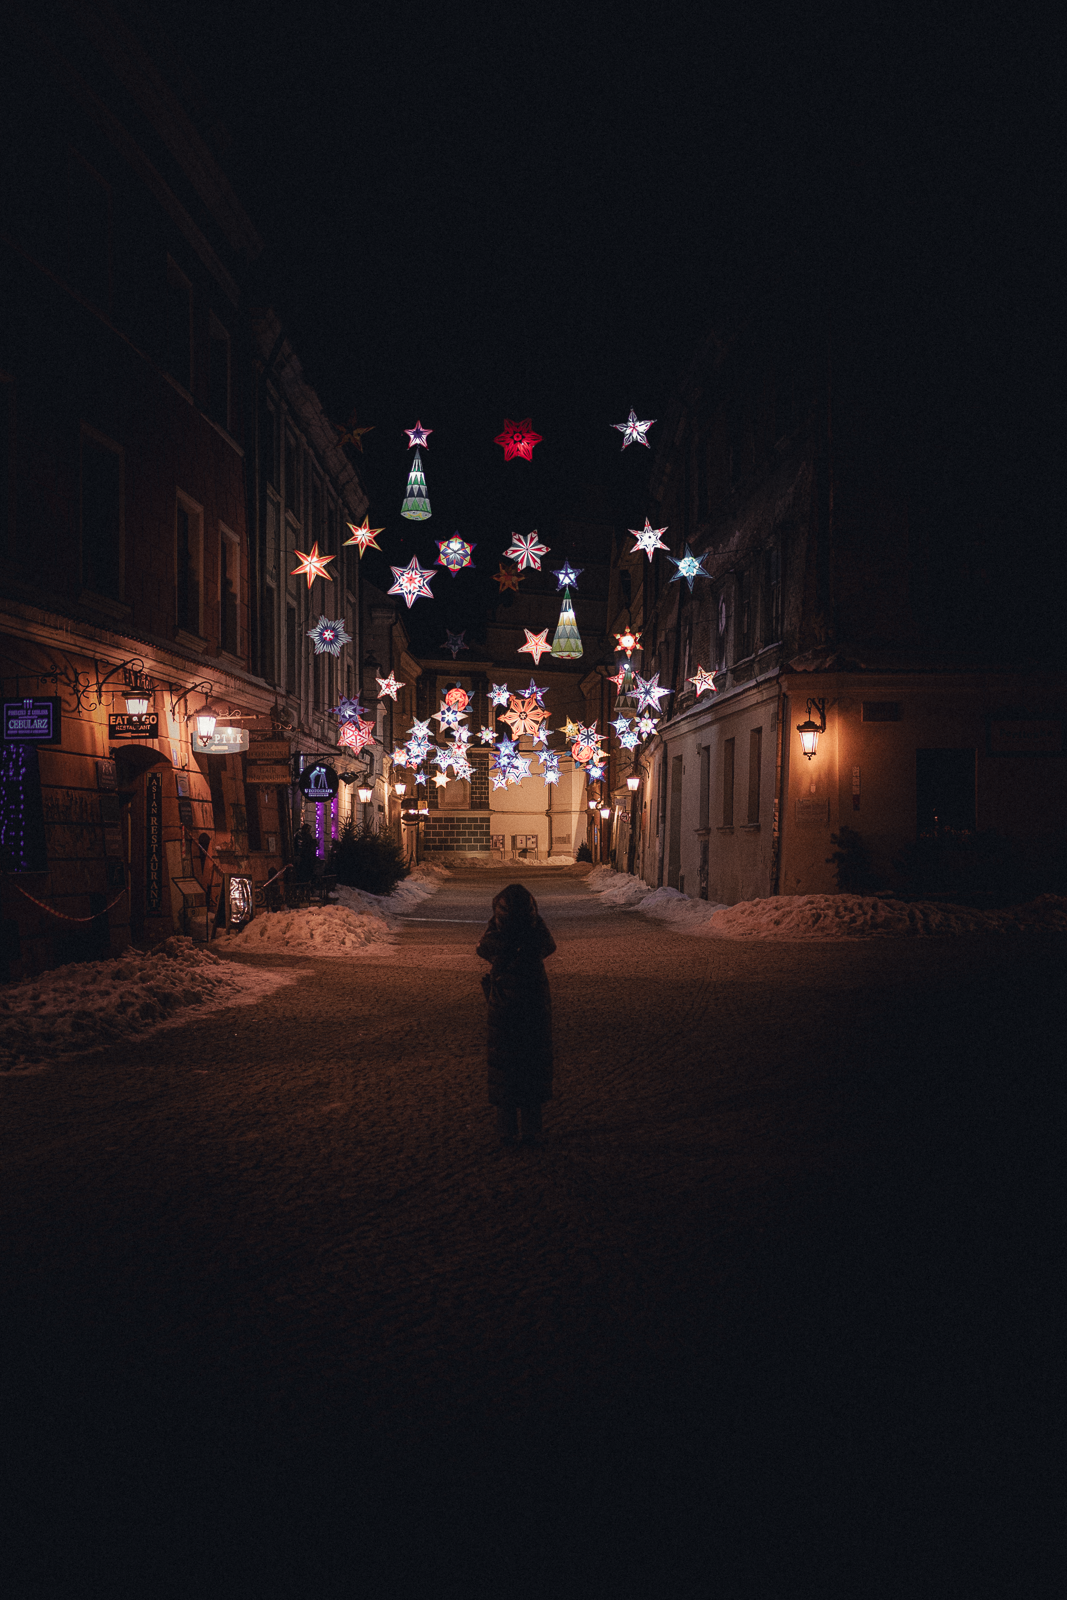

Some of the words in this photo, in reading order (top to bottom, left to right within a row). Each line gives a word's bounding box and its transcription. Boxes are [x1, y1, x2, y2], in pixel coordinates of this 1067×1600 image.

[8, 719, 48, 729] CEBULARZ
[110, 715, 129, 725] EAT
[142, 715, 157, 725] GO
[214, 733, 244, 744] PTTK
[150, 816, 158, 908] RESTAURANT
